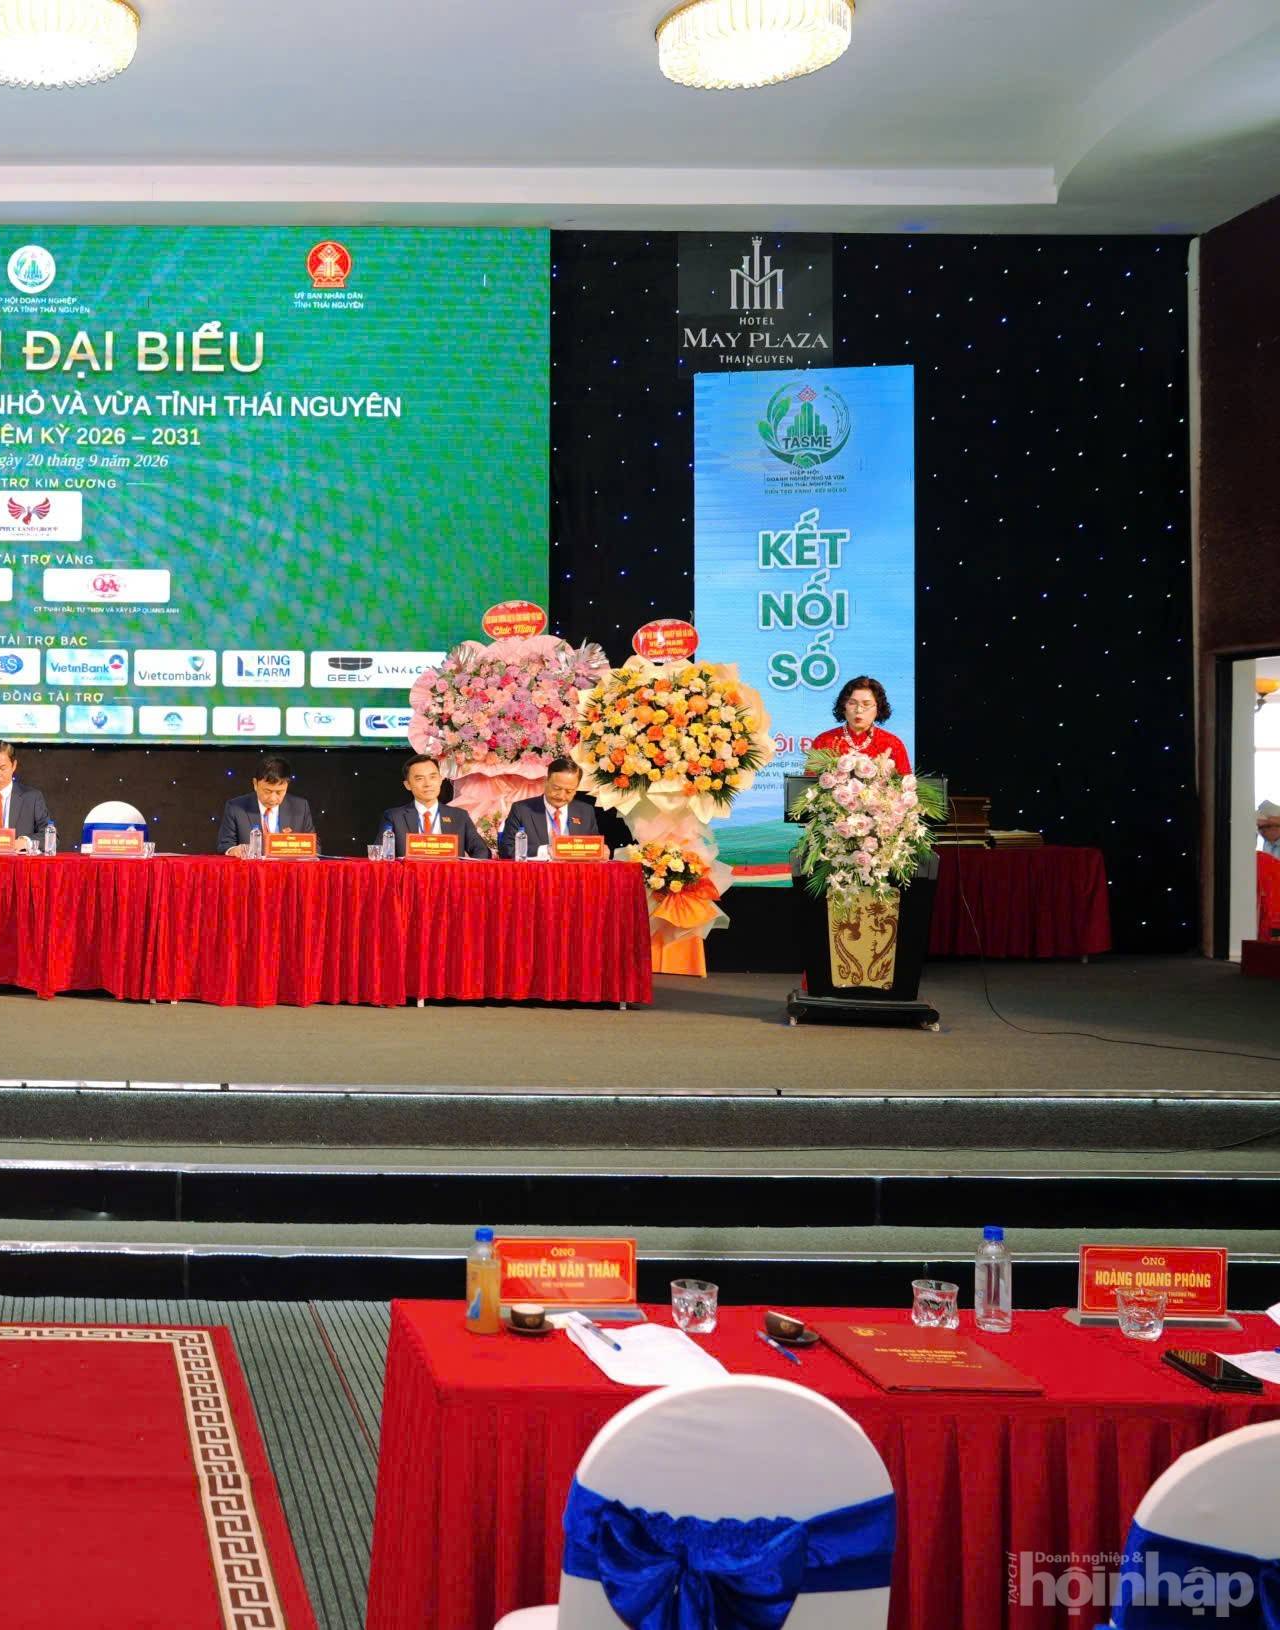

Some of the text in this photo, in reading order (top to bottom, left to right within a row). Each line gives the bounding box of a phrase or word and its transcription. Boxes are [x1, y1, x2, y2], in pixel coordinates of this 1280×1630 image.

[740, 317, 774, 326] HOTEL
[683, 328, 829, 348] MAY PLAZA
[22, 330, 113, 378] ĐẠI
[138, 321, 264, 373] BIỂU
[720, 355, 793, 364] THAINGUYEN
[52, 392, 86, 416] VÀ
[94, 390, 150, 416] VỪA
[156, 391, 216, 416] TỈNH
[224, 393, 282, 416] THÁI
[291, 392, 402, 417] NGUYÊN
[40, 424, 70, 445] KỲ
[77, 428, 125, 445] 2026
[151, 429, 200, 446] 2031
[782, 436, 831, 449] TASME
[26, 454, 44, 466] 20
[47, 453, 85, 470] tháng
[88, 454, 98, 467] 9
[100, 454, 131, 468] năm
[134, 454, 168, 468] 2026
[1, 477, 30, 488] TRỢ
[34, 477, 59, 488] KIM
[64, 477, 116, 488] CƯƠNG
[762, 511, 846, 566] KẾT
[20, 554, 51, 565] TRỢ
[56, 554, 94, 565] VÀNG
[762, 572, 844, 626] NỐI
[0, 635, 20, 647] TÀI
[26, 635, 56, 647] TRỢ
[60, 635, 88, 647] BẠC
[257, 656, 290, 666] KING
[772, 633, 836, 686] SỐ
[51, 663, 109, 673] VietinBank
[257, 668, 290, 677] FARM
[138, 671, 211, 681] Vietcombank
[328, 674, 371, 682] GEELY
[2, 692, 42, 704] ĐỒNG
[48, 692, 70, 704] TÀI
[74, 692, 104, 704] TRỢ
[774, 733, 793, 756] ỘI
[551, 1246, 576, 1256] ÔNG
[1142, 1256, 1166, 1266] ÔNG
[508, 1258, 620, 1278] NGUYỄN VĂN THÂN
[1096, 1269, 1132, 1286] HOÀNG
[1136, 1272, 1172, 1288] QUANG
